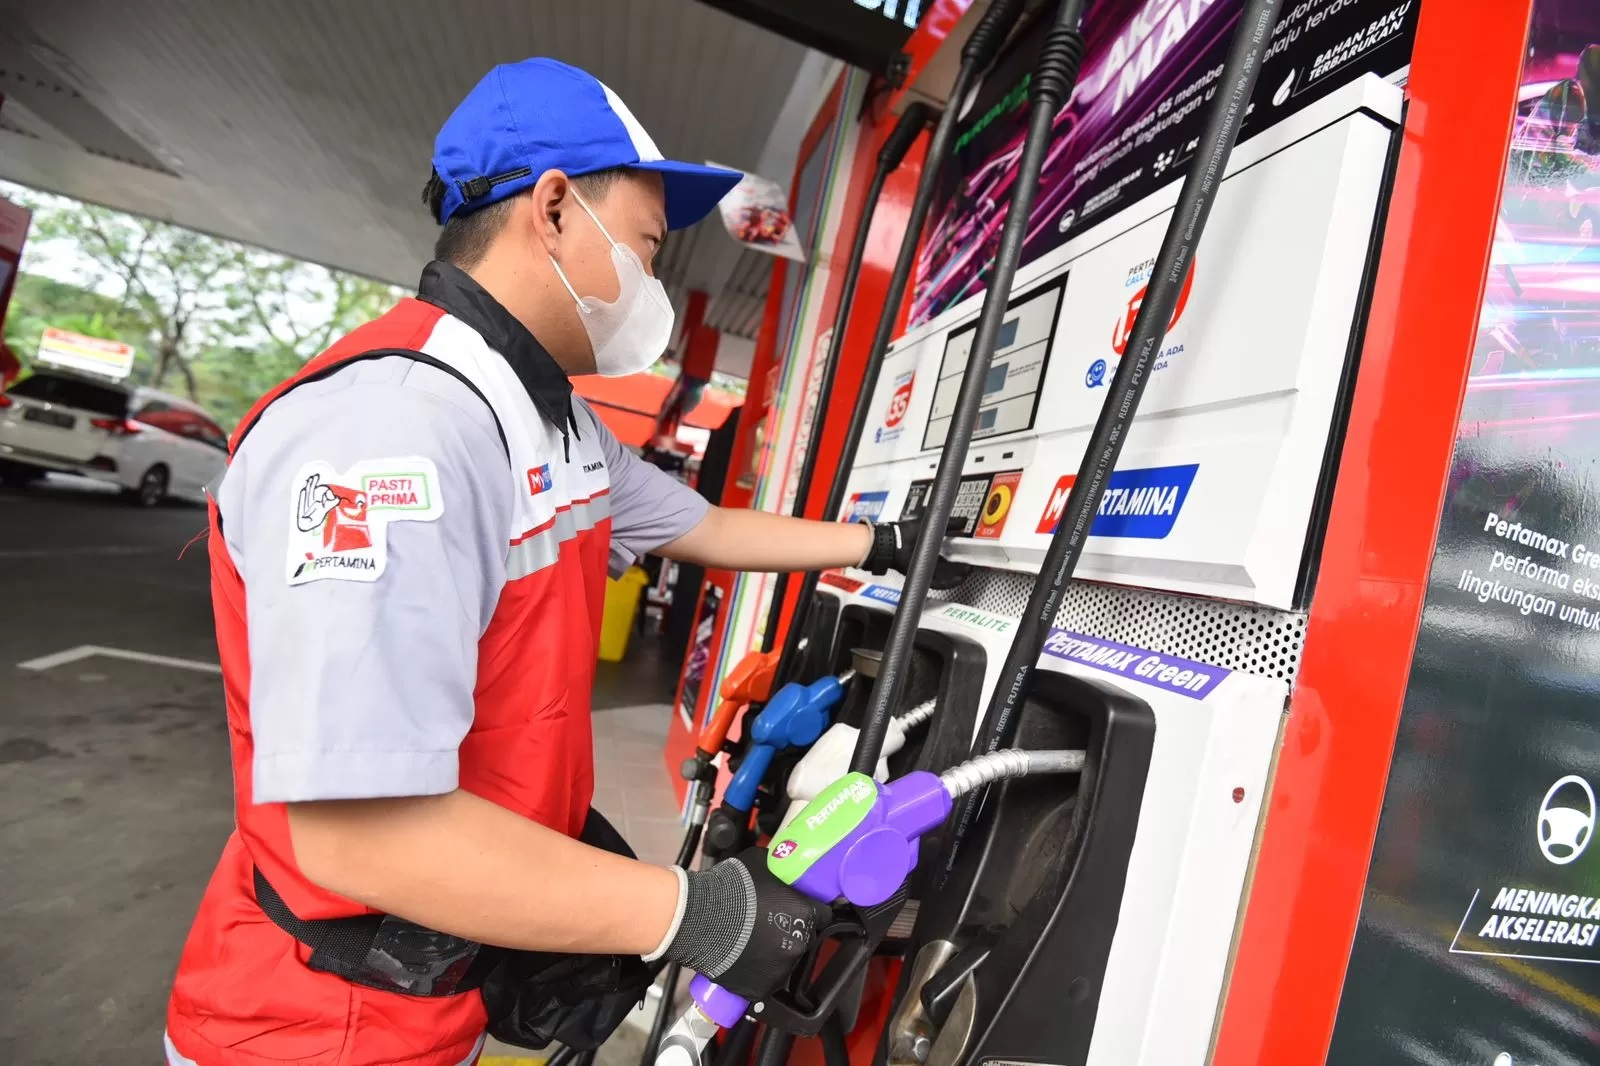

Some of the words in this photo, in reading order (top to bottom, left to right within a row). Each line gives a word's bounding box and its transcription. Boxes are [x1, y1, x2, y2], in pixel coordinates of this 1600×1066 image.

[1253, 9, 1269, 42] FLEXSTEEL
[1314, 28, 1365, 68] BAHAN
[1367, 1, 1410, 36] BAKU
[1308, 17, 1404, 82] TERBARUKAN
[1134, 95, 1203, 148] lingkungan
[1157, 97, 1173, 118] 95
[1119, 388, 1134, 418] FLEXSTEEL
[1130, 335, 1155, 384] FUTURA
[368, 479, 413, 491] PASTI
[371, 492, 418, 505] PRIMA
[1484, 512, 1569, 559] Pertamax
[1572, 544, 1600, 569] Gre
[313, 556, 377, 570] PERTAMINA
[1489, 550, 1570, 590] performa
[1458, 569, 1556, 616] lingkungan
[1559, 604, 1600, 632] untuk
[943, 607, 1011, 632] PERTALITE
[1045, 631, 1142, 672] PERTAMAX
[1134, 656, 1211, 692] Green
[1007, 663, 1027, 704] FUTURA
[775, 842, 793, 858] 95
[1491, 886, 1600, 920] MENINGKA
[1479, 915, 1600, 946] AKSELERASI
